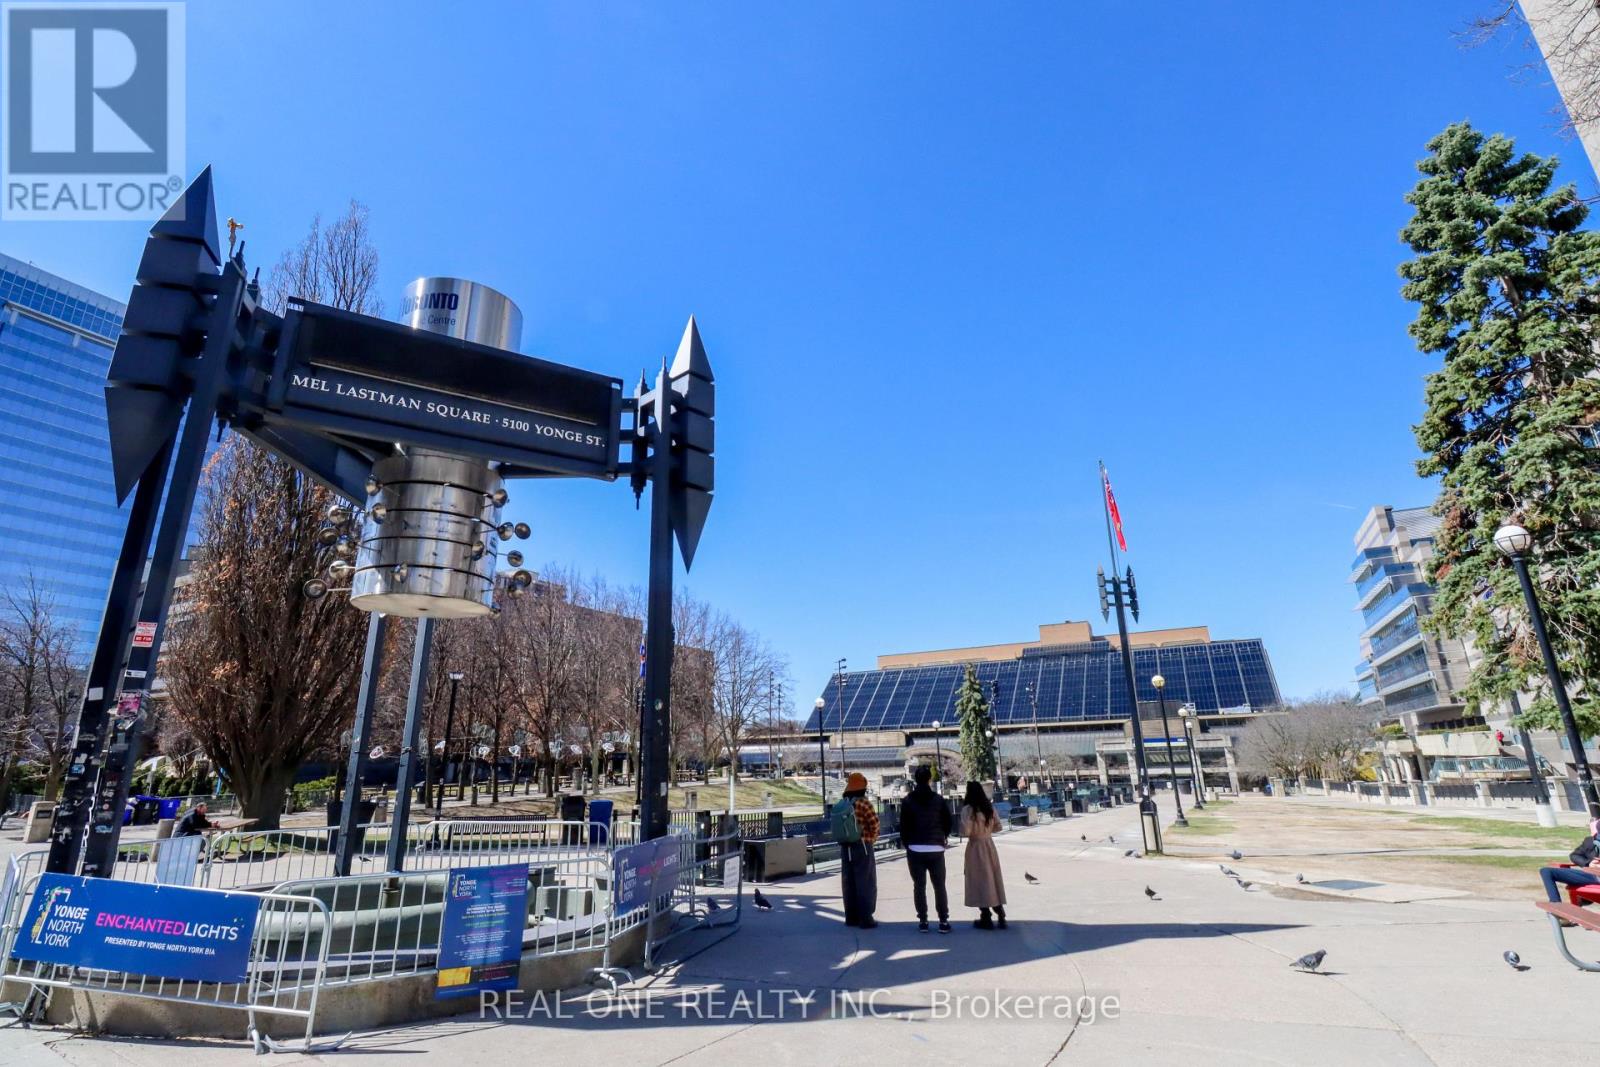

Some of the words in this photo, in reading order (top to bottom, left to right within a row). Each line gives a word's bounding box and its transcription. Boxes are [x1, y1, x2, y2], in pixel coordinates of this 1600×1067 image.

[292, 374, 330, 392] MEL
[336, 383, 421, 410] LASTMAN
[426, 402, 491, 425] SQUARE
[502, 418, 530, 432] 5100
[534, 424, 582, 443] YONGE
[586, 434, 606, 448] ST.
[54, 904, 89, 920] YONGE
[47, 919, 84, 935] NORTH
[44, 932, 72, 948] YORK
[104, 936, 138, 947] PRESENTED
[146, 941, 166, 951] YONGE
[166, 944, 187, 953] NORTH
[187, 946, 204, 954] YORK
[204, 947, 216, 955] BIA
